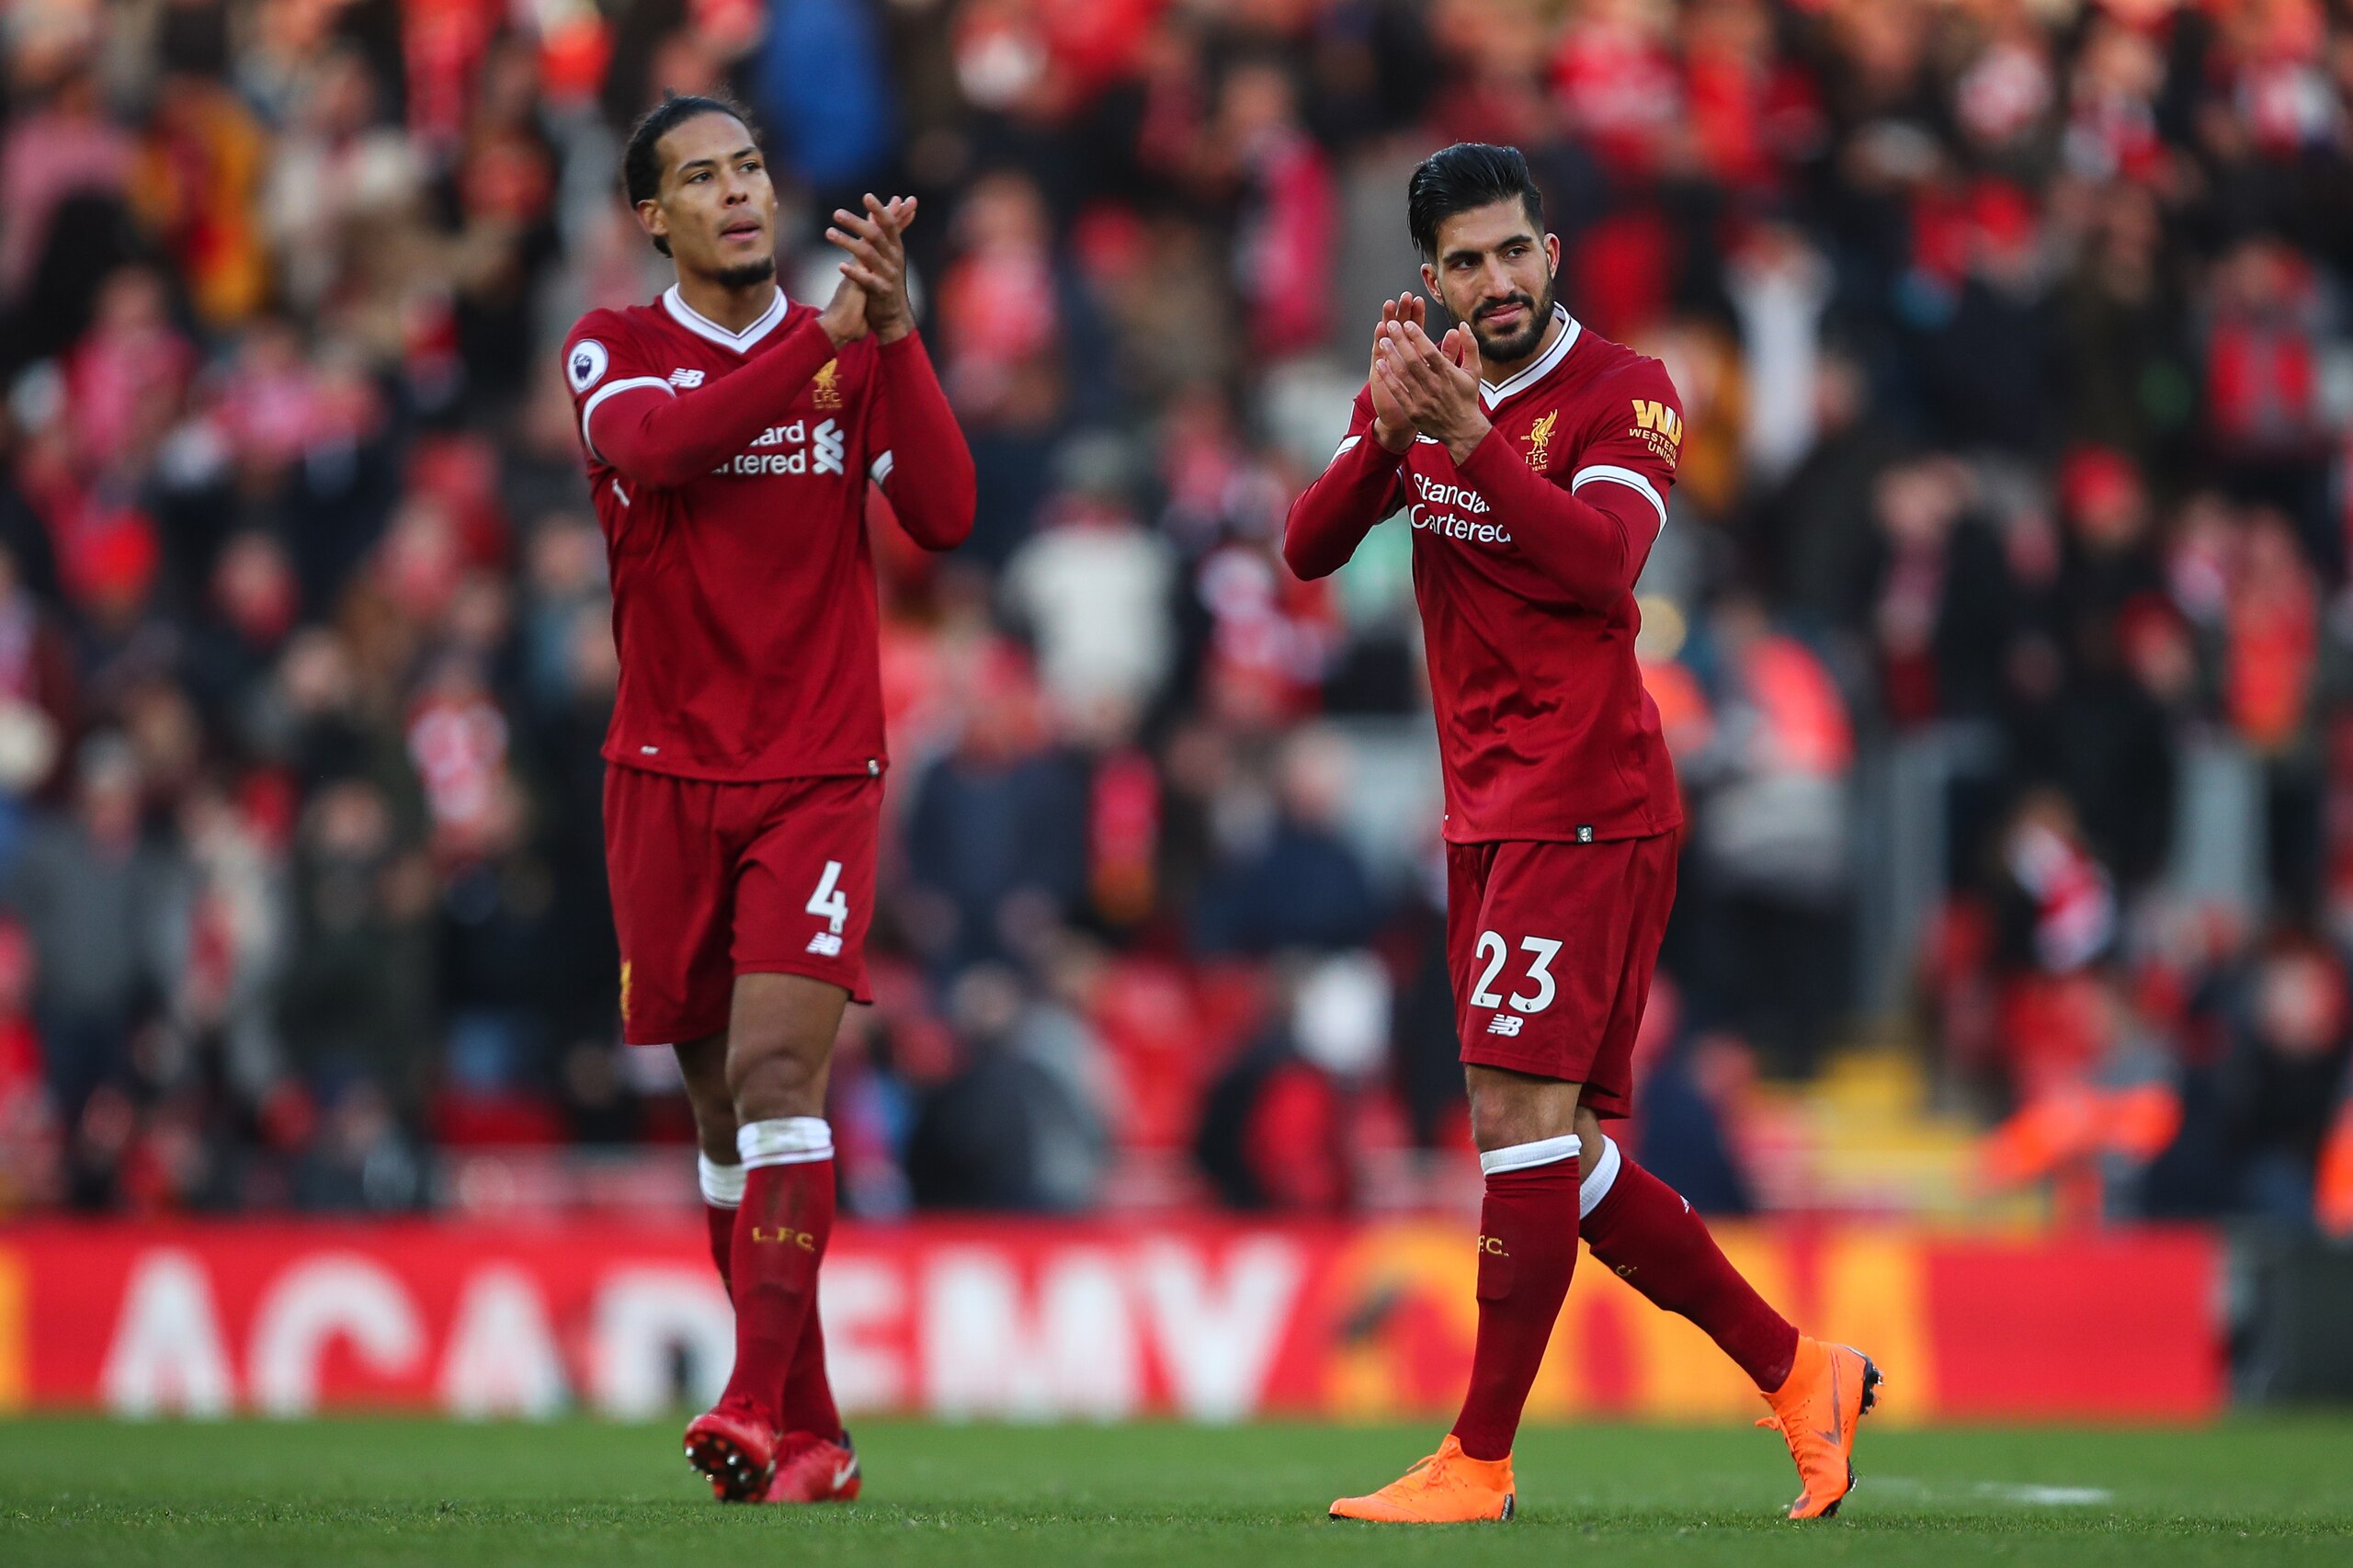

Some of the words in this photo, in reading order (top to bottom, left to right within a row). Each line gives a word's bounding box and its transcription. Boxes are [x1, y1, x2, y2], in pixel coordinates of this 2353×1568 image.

[1629, 428, 1677, 460] WESTERN
[1631, 399, 1682, 447] WU
[1647, 441, 1677, 469] UNION
[1413, 472, 1491, 514] Standa
[805, 859, 849, 935] 4
[1470, 930, 1563, 1014] 23
[101, 1233, 1305, 1422] ACADEMY
